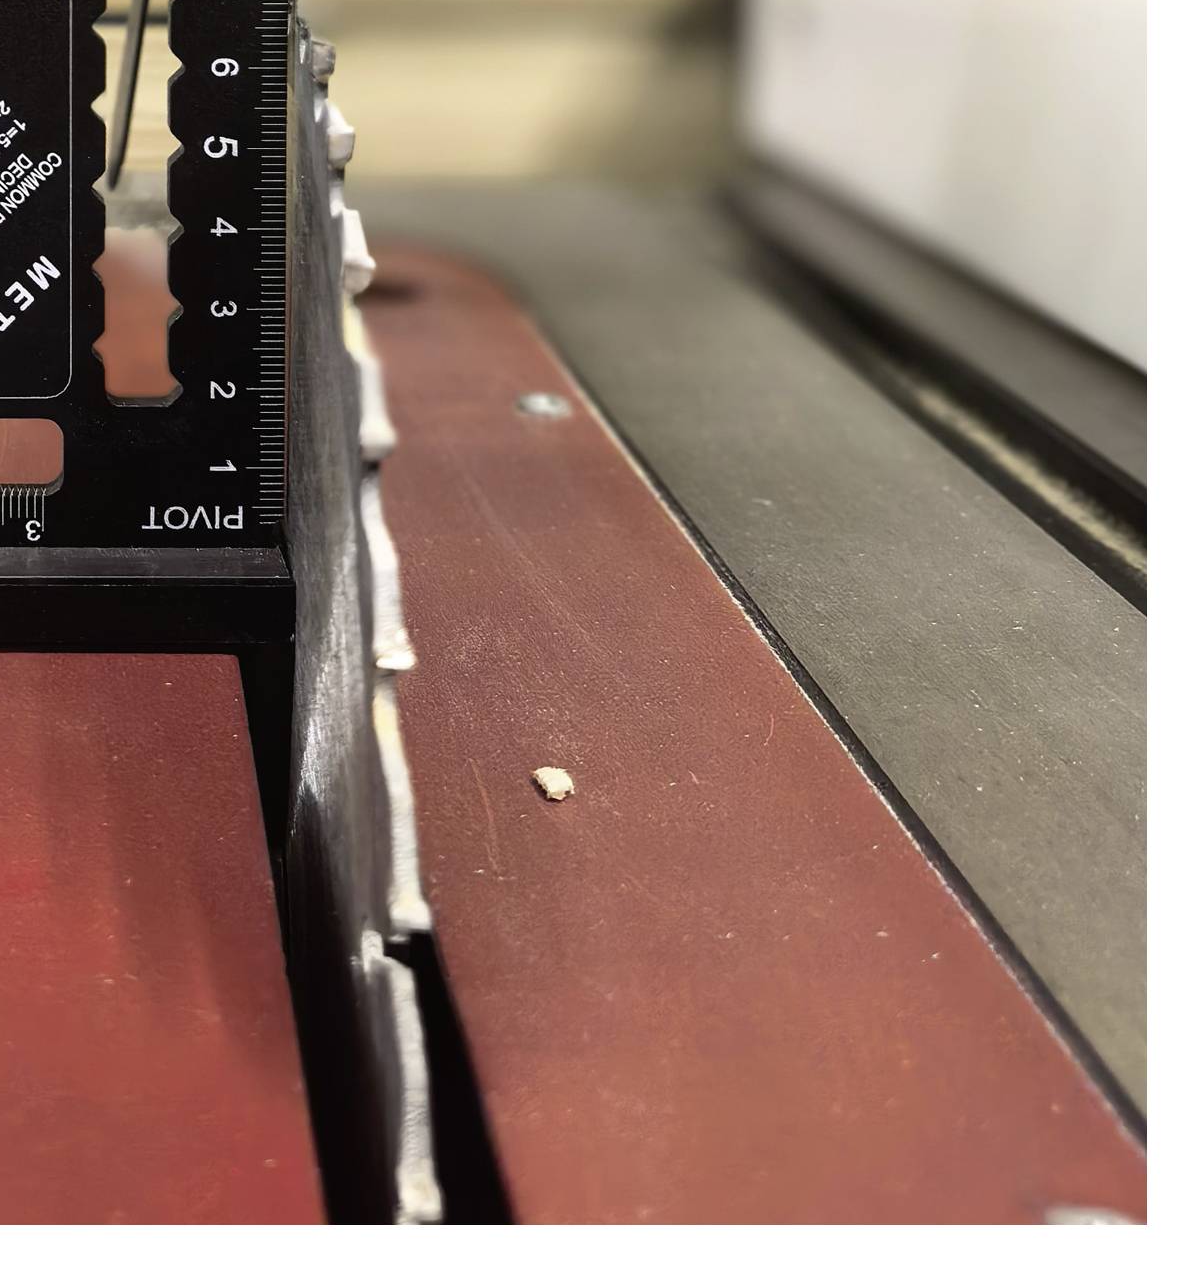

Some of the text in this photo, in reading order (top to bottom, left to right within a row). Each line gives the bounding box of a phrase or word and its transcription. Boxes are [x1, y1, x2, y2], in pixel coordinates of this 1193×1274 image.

[211, 58, 239, 76] 6
[204, 136, 238, 158] 5
[0, 153, 62, 214] COMMON
[211, 217, 237, 236] 4
[211, 301, 237, 317] 3
[211, 381, 235, 398] 2
[210, 460, 236, 471] 1
[142, 506, 243, 529] PIVOT
[26, 520, 42, 541] 3
